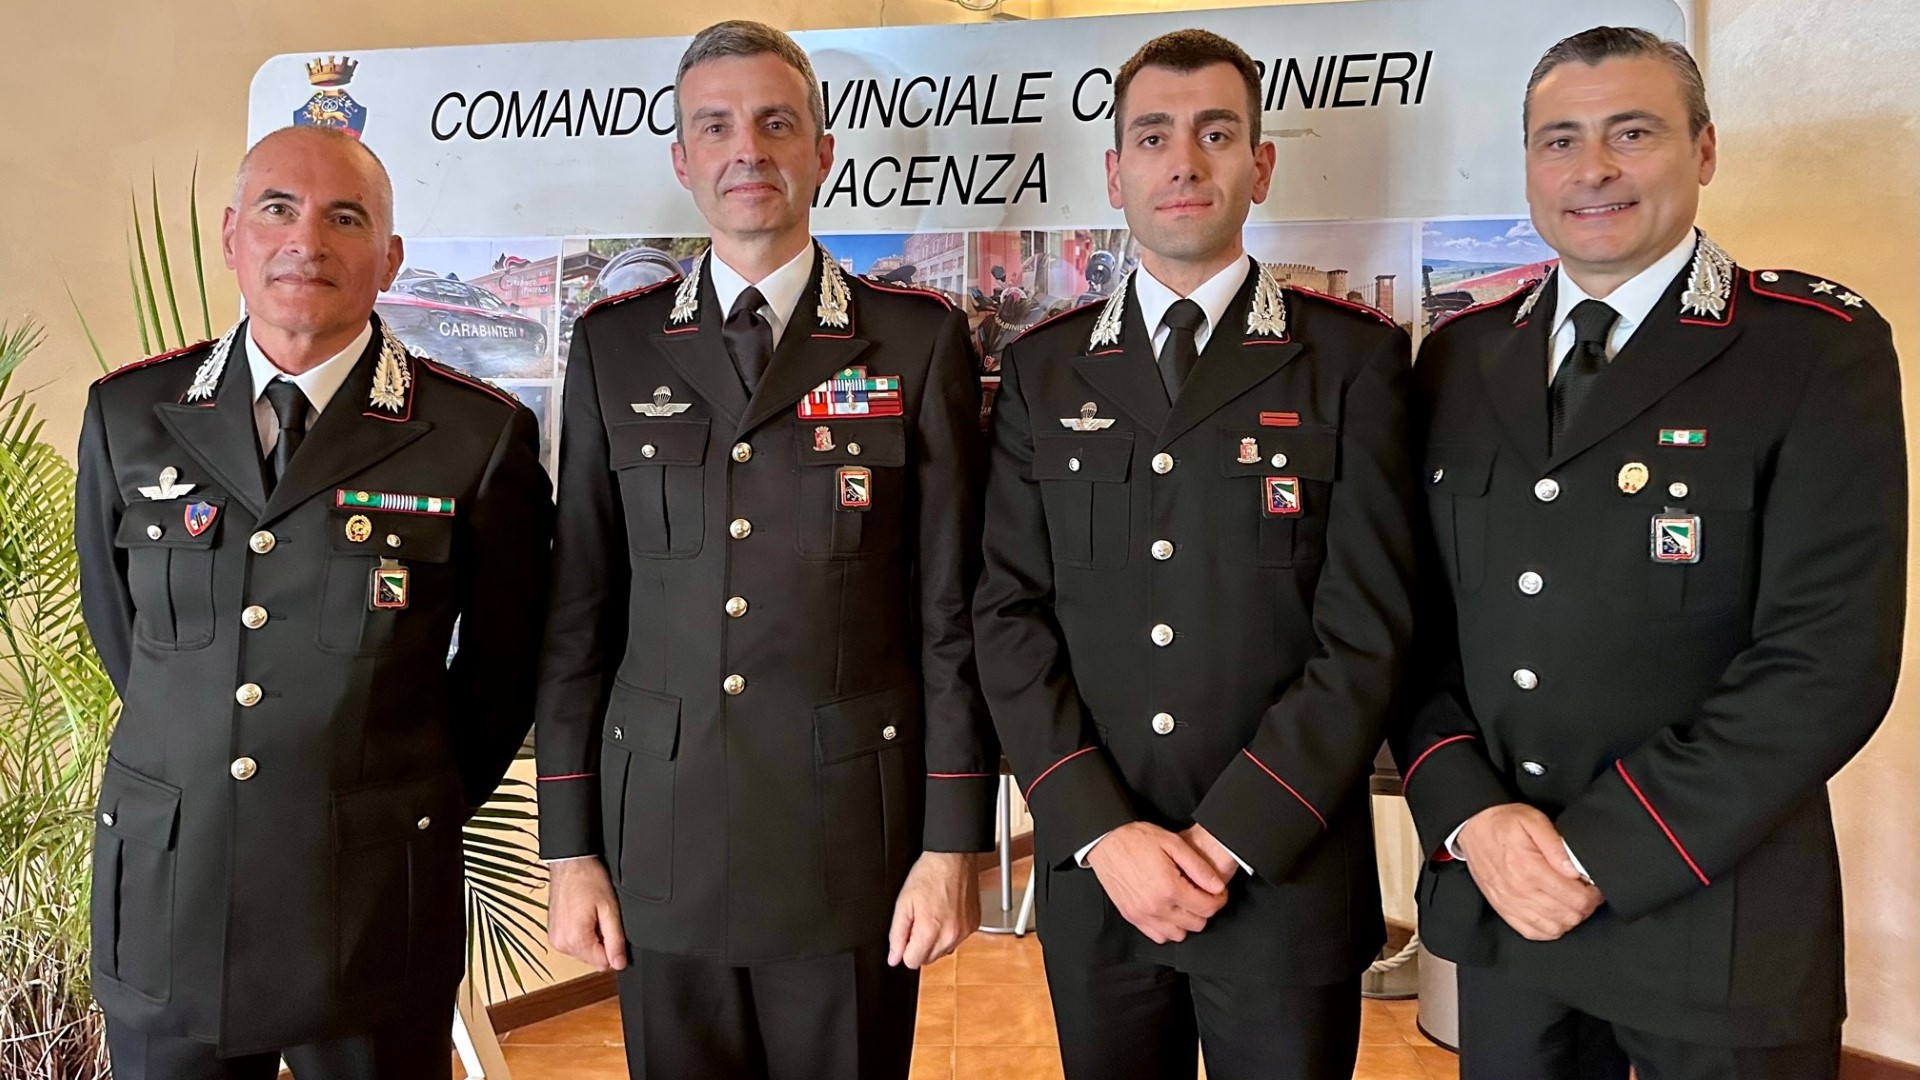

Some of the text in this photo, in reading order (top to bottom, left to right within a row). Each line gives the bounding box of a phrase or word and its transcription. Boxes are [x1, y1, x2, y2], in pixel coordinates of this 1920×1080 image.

[431, 85, 676, 141] COMANDO
[821, 71, 1052, 130] VINCIALE
[811, 152, 1048, 208] ACENZA
